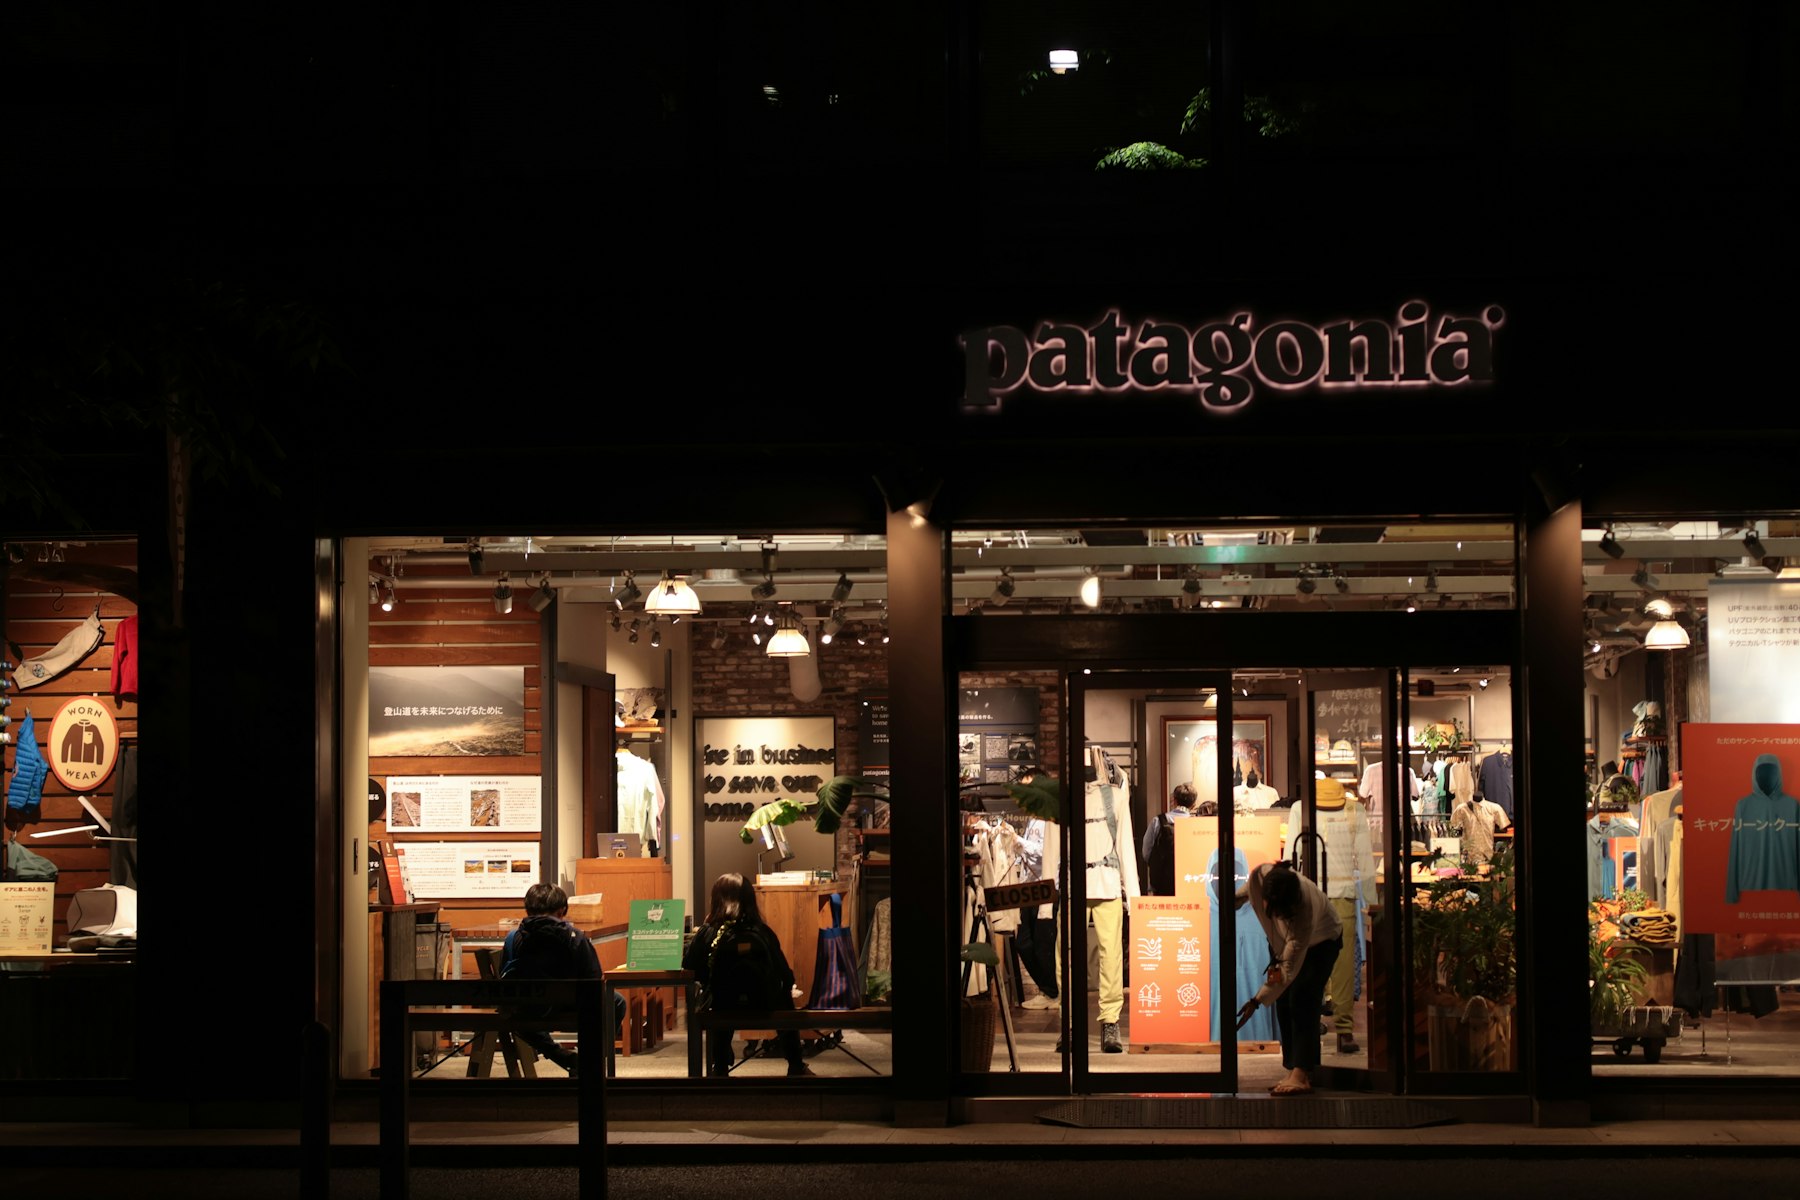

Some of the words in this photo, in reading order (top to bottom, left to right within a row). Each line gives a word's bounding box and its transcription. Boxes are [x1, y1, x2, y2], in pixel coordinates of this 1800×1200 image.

[959, 302, 1497, 411] patagonia
[67, 706, 103, 718] WORN
[384, 706, 503, 717] 登山道を未来につなげるために
[66, 769, 98, 780] WEAR
[1694, 818, 1800, 832] キャプリーン・クー
[990, 884, 1052, 907] CLOSED
